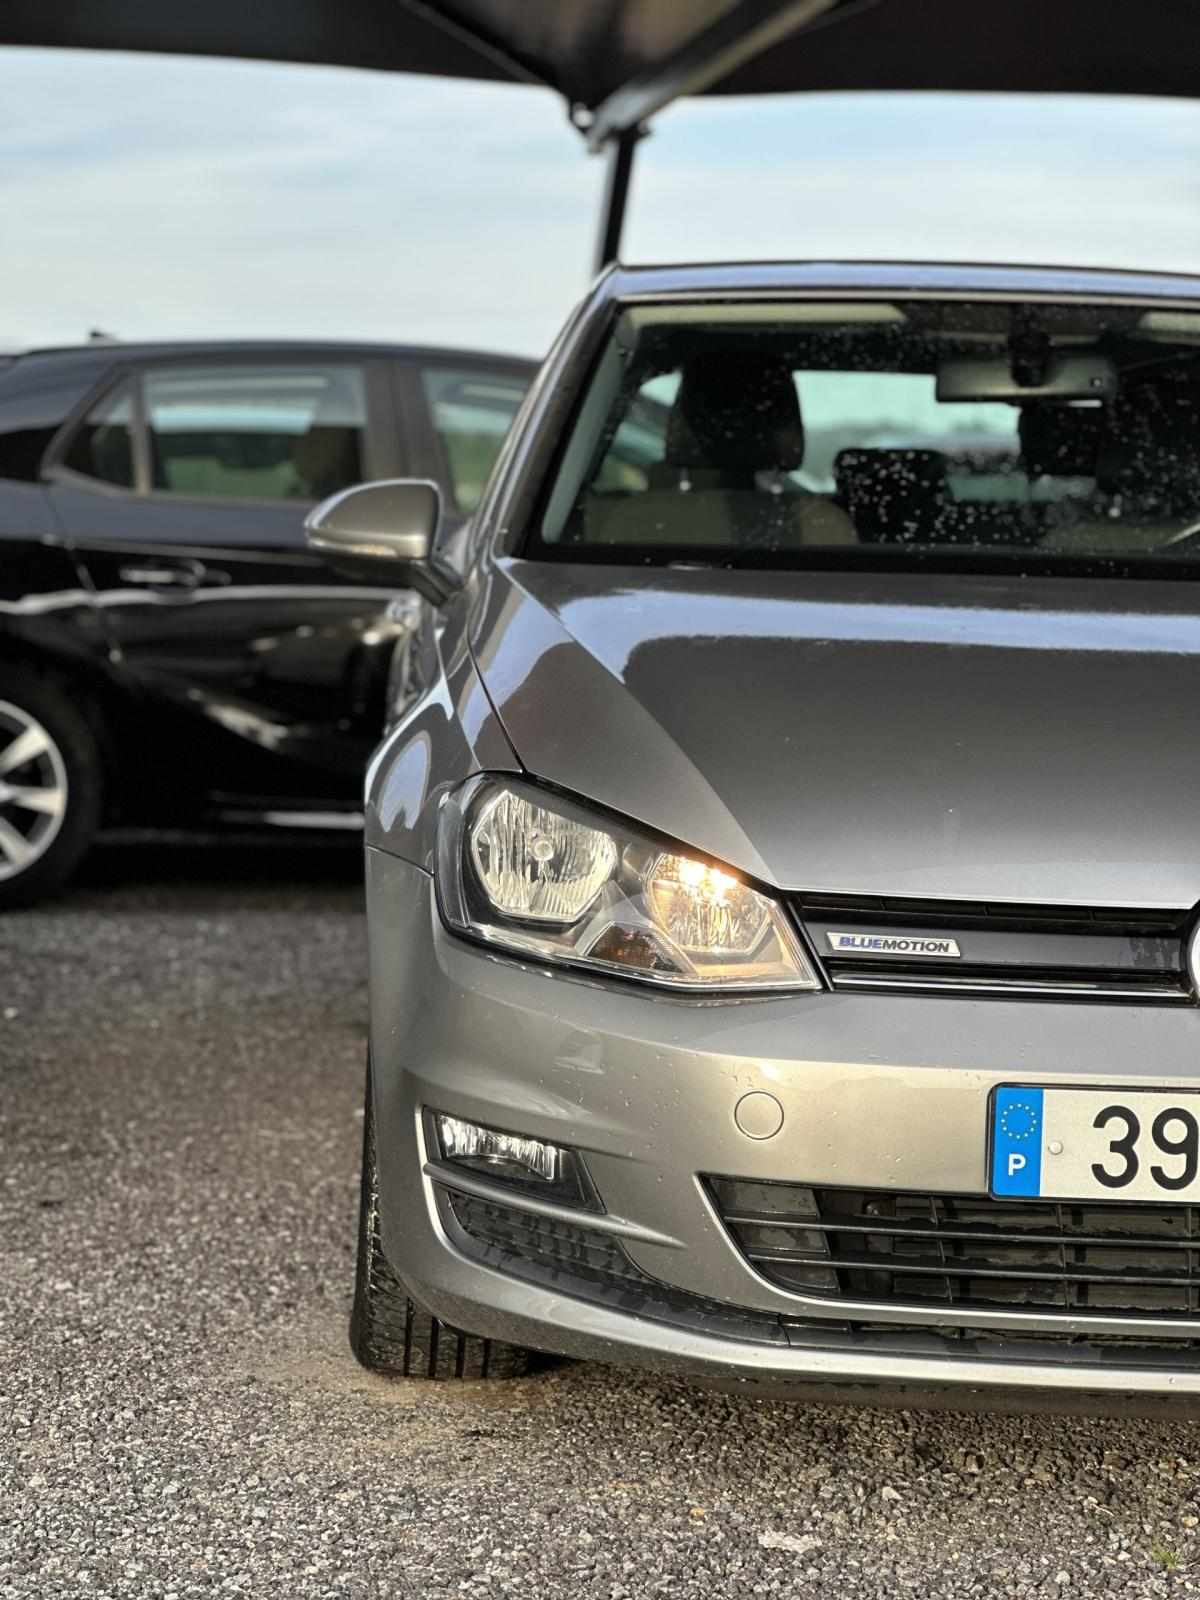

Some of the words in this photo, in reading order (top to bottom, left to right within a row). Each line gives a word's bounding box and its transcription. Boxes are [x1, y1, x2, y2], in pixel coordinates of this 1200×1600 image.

[839, 936, 950, 953] BLUEMOTION
[1091, 1104, 1199, 1191] 39
[1007, 1152, 1026, 1176] P
